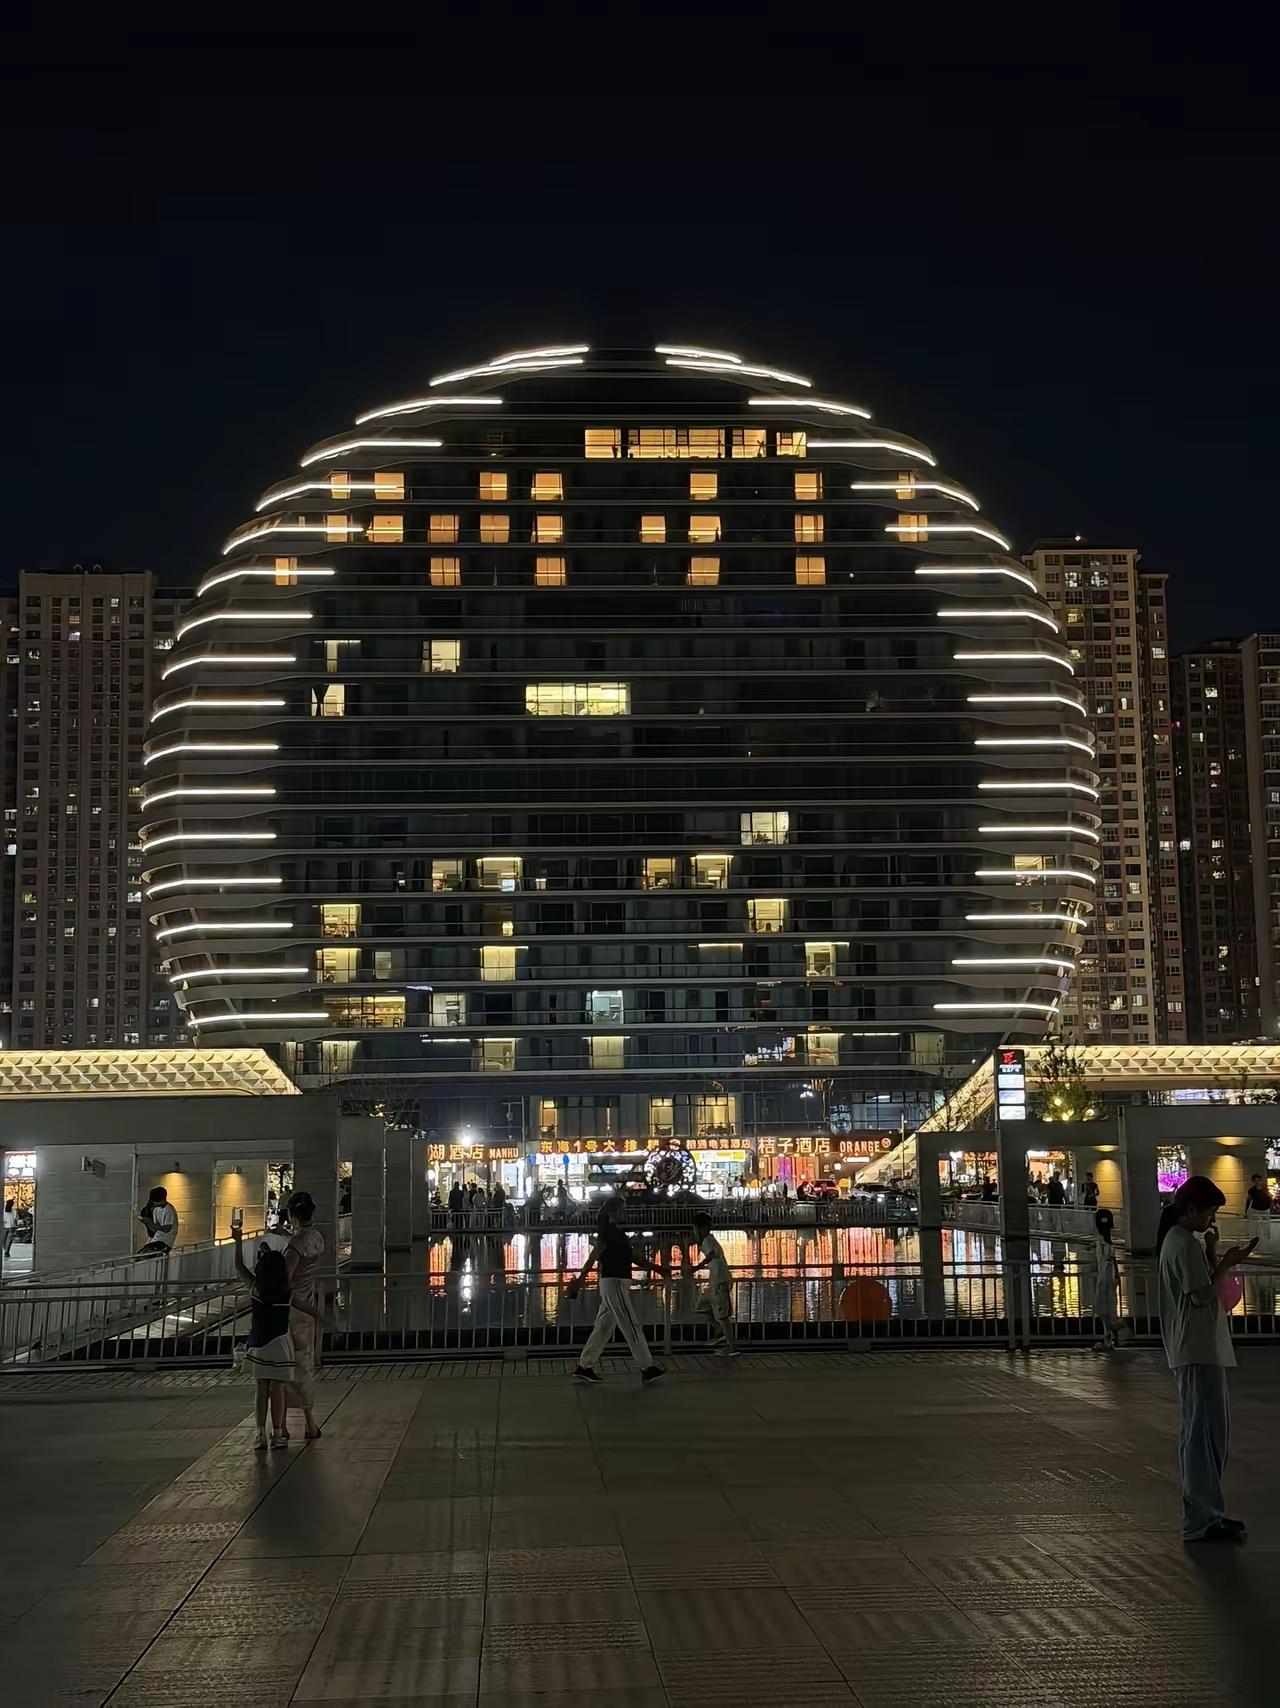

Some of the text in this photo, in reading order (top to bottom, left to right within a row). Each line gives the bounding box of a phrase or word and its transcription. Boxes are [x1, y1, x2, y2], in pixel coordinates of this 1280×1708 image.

[757, 1137, 880, 1154] 桔子酒店 ORANGE
[489, 1147, 519, 1159] NANHU
